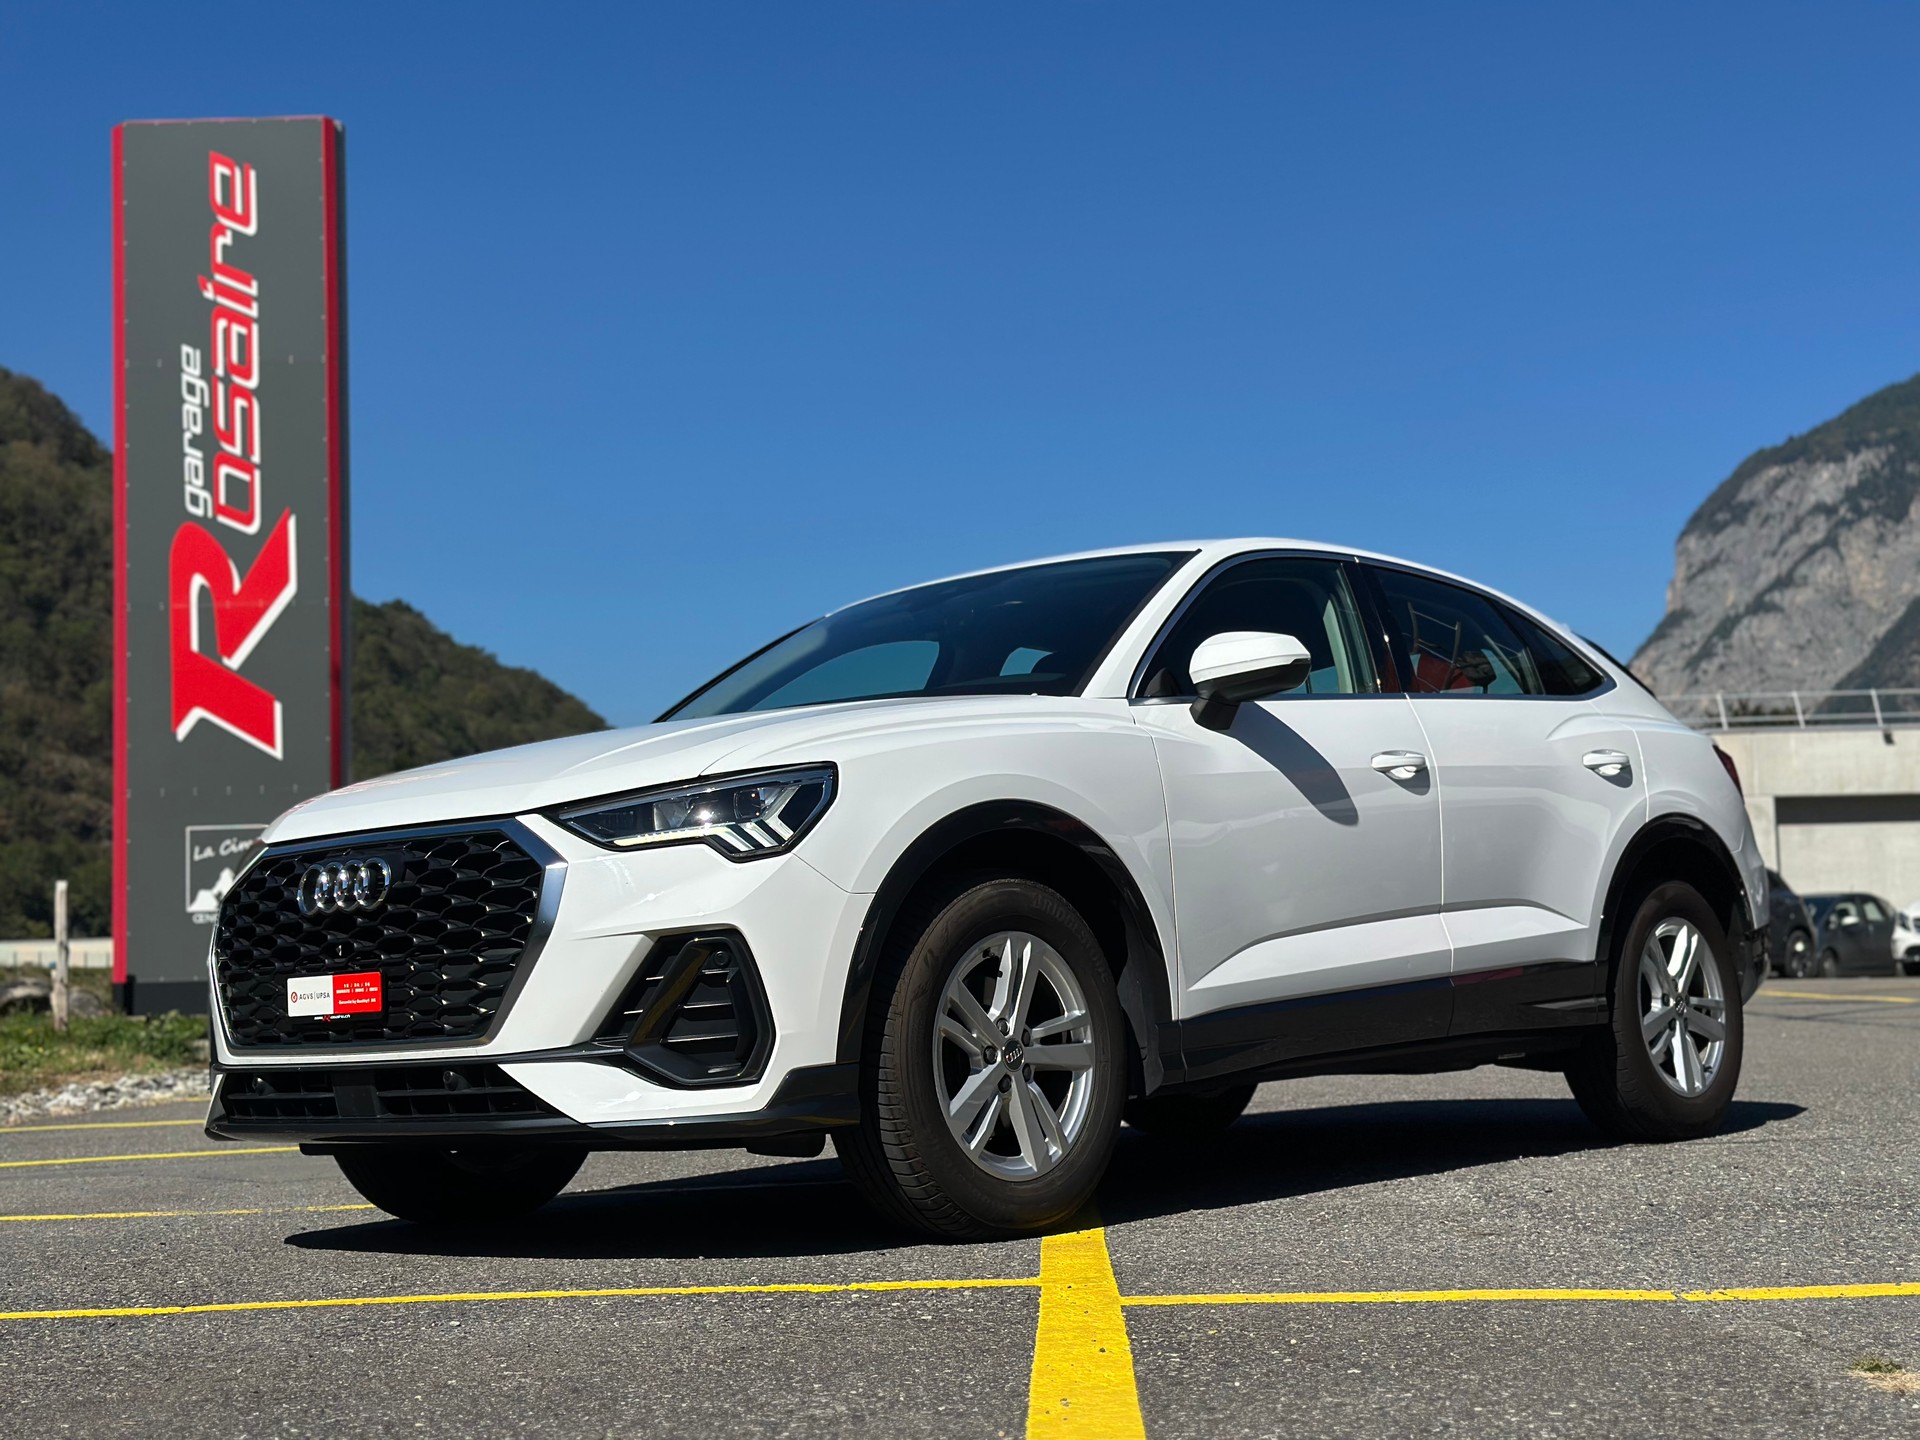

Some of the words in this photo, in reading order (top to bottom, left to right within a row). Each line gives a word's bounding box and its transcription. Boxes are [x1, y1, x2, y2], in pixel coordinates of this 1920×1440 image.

[169, 150, 298, 761] Rosaire
[180, 345, 213, 519] garage
[193, 845, 216, 861] La
